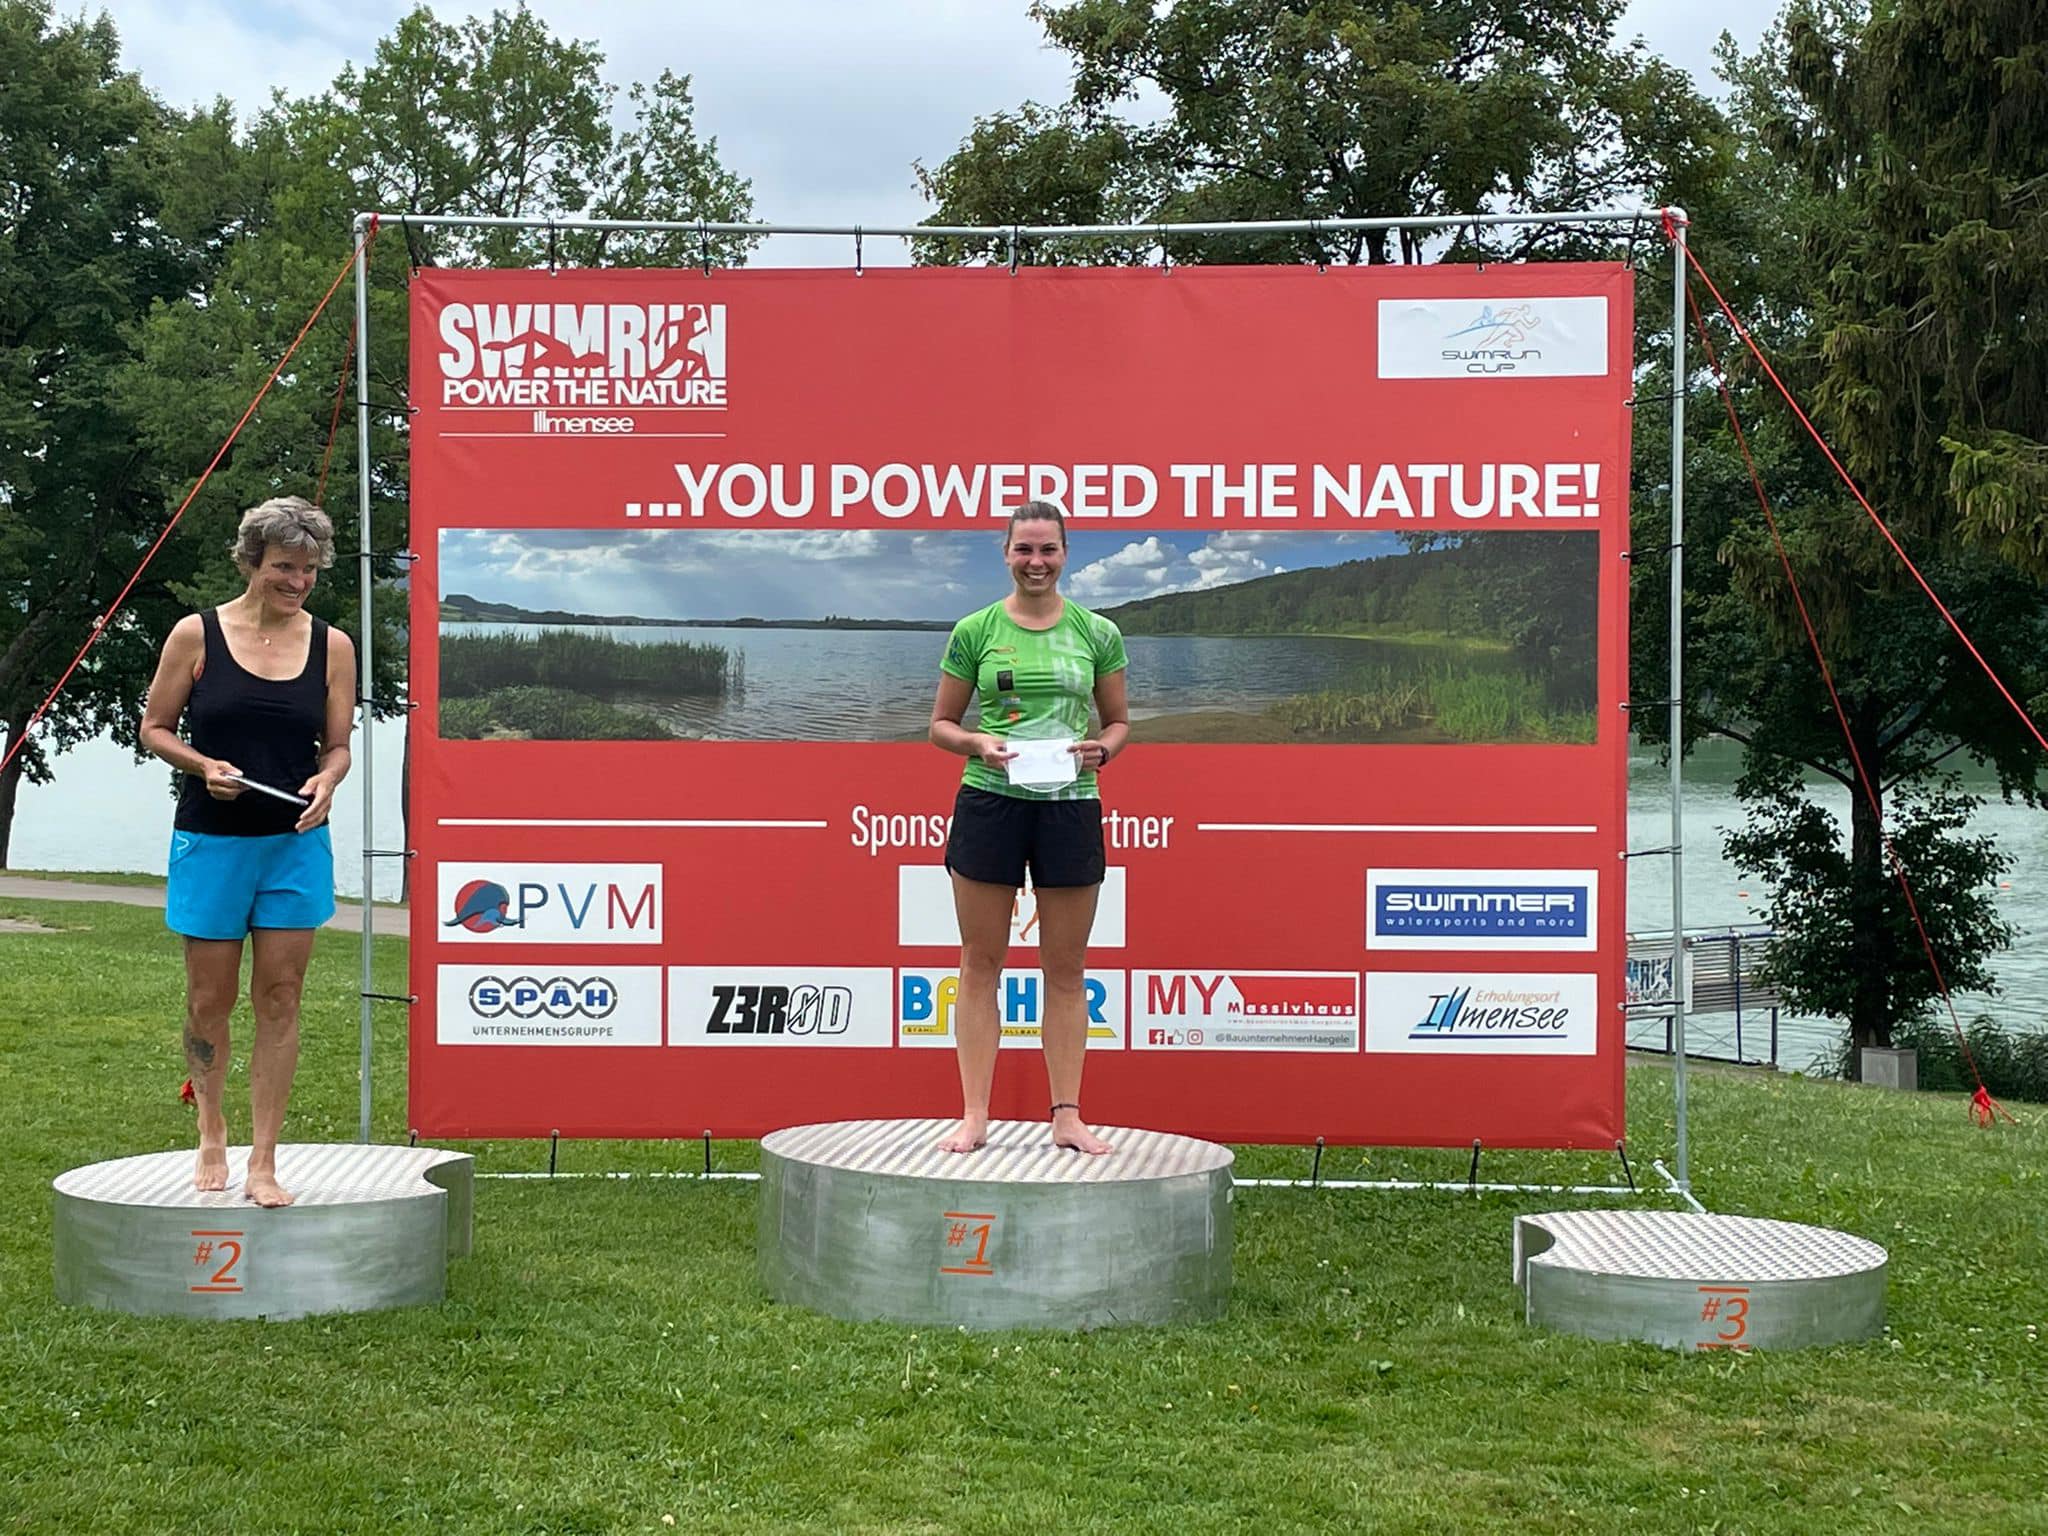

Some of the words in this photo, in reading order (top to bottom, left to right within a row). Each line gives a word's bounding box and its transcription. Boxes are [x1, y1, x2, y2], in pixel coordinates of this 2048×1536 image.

[439, 303, 727, 379] SWIMRUN
[1442, 350, 1541, 360] SWIMRUN
[1466, 363, 1516, 373] CUP
[443, 379, 550, 405] POWER
[553, 379, 609, 405] THE
[615, 379, 728, 405] NATURE
[533, 411, 634, 433] Illmensee
[831, 463, 1159, 518] POWERED
[1171, 464, 1297, 518] THE
[1313, 463, 1600, 518] NATURE!
[1101, 809, 1174, 849] tner
[518, 883, 655, 930] PVM
[1386, 893, 1576, 913] SWIMMER
[1386, 917, 1487, 928] watersports
[1498, 917, 1526, 927] and
[1536, 919, 1575, 927] more
[478, 985, 608, 1007] SPÄH
[902, 975, 1107, 1023] BAHR
[1147, 974, 1225, 1015] MY
[1227, 1001, 1354, 1015] Massivhaus
[1417, 986, 1570, 1033] Illmensee
[1475, 989, 1560, 1006] Erholungsort
[472, 1026, 614, 1037] UNTERNEHMENSGRUPPE
[946, 1223, 992, 1266] #1
[193, 1240, 242, 1283] #2
[1701, 1296, 1749, 1341] #3
